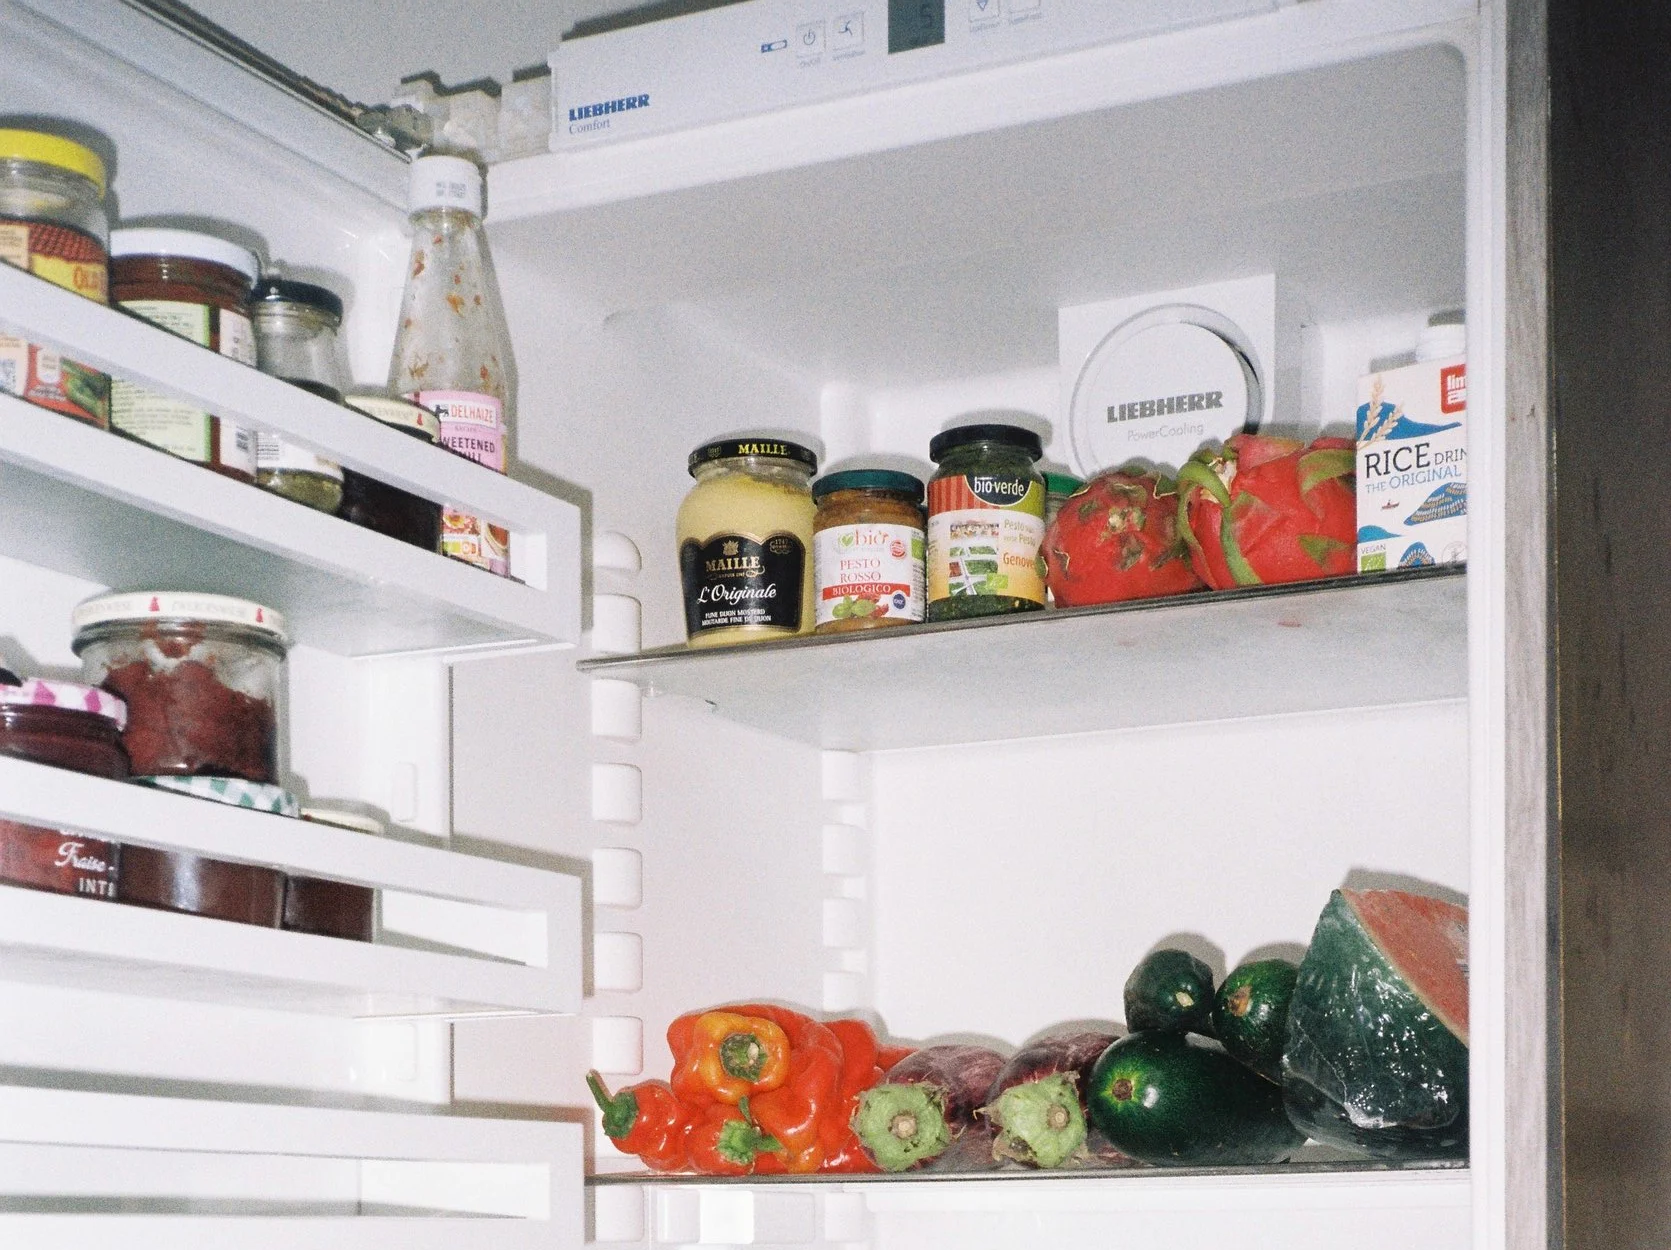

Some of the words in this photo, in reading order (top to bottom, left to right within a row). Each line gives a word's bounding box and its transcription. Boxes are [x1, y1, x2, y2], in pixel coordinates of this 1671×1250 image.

[568, 93, 650, 122] LIEBHERR
[568, 119, 611, 135] Comfort
[451, 404, 494, 424] DELHAIZE
[1106, 391, 1224, 423] LIEBHERR
[1127, 422, 1204, 441] PowerCooling
[442, 436, 496, 453] WEETENED
[738, 443, 788, 456] MAILLE
[1364, 442, 1431, 478] RICE
[1434, 448, 1467, 466] DRIN
[1365, 481, 1387, 494] THE
[1389, 464, 1462, 489] ORIGINAL
[1360, 543, 1387, 555] VEGAN
[705, 556, 761, 572] MAILLE
[840, 558, 881, 571] PESTO
[1003, 552, 1036, 569] Genove
[840, 571, 882, 583] ROSSO
[696, 583, 777, 606] L'Originale
[832, 584, 891, 596] BIOLOGICO
